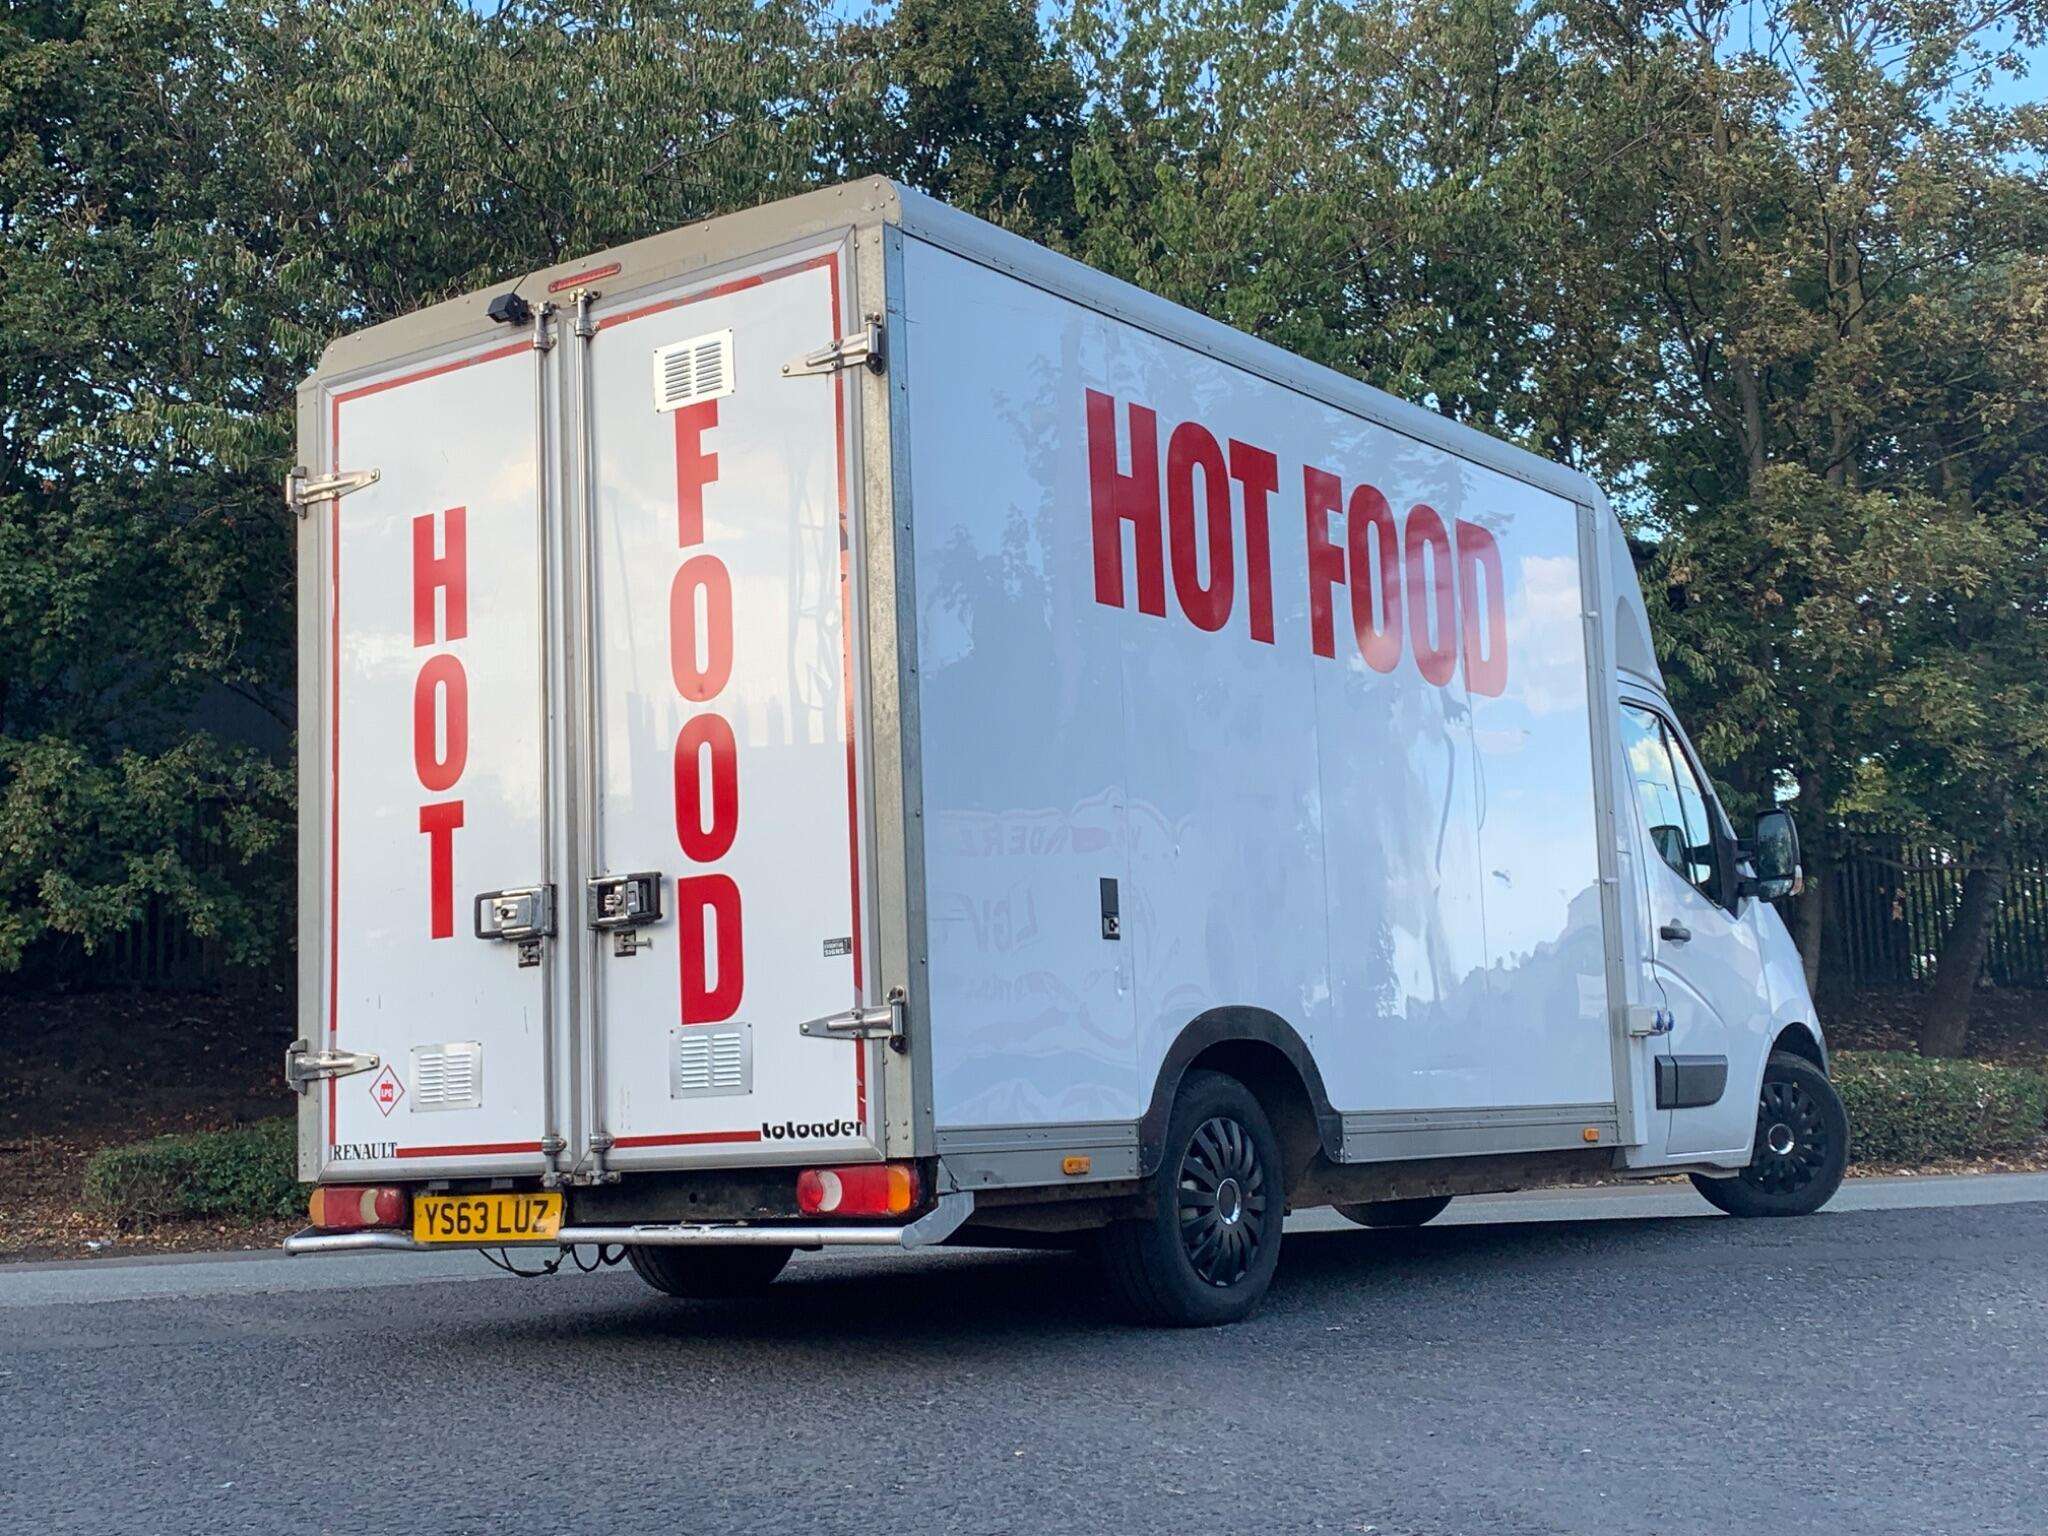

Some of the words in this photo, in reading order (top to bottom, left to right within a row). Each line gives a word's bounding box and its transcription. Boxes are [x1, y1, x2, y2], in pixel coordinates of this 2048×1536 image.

[1085, 387, 1279, 645] HOT
[1303, 464, 1509, 698] FOOD
[412, 506, 468, 940] HOT
[671, 398, 745, 1026] FOOD
[333, 1142, 398, 1160] RENAULT
[424, 1201, 489, 1235] YS63
[497, 1199, 549, 1234] LUZ
